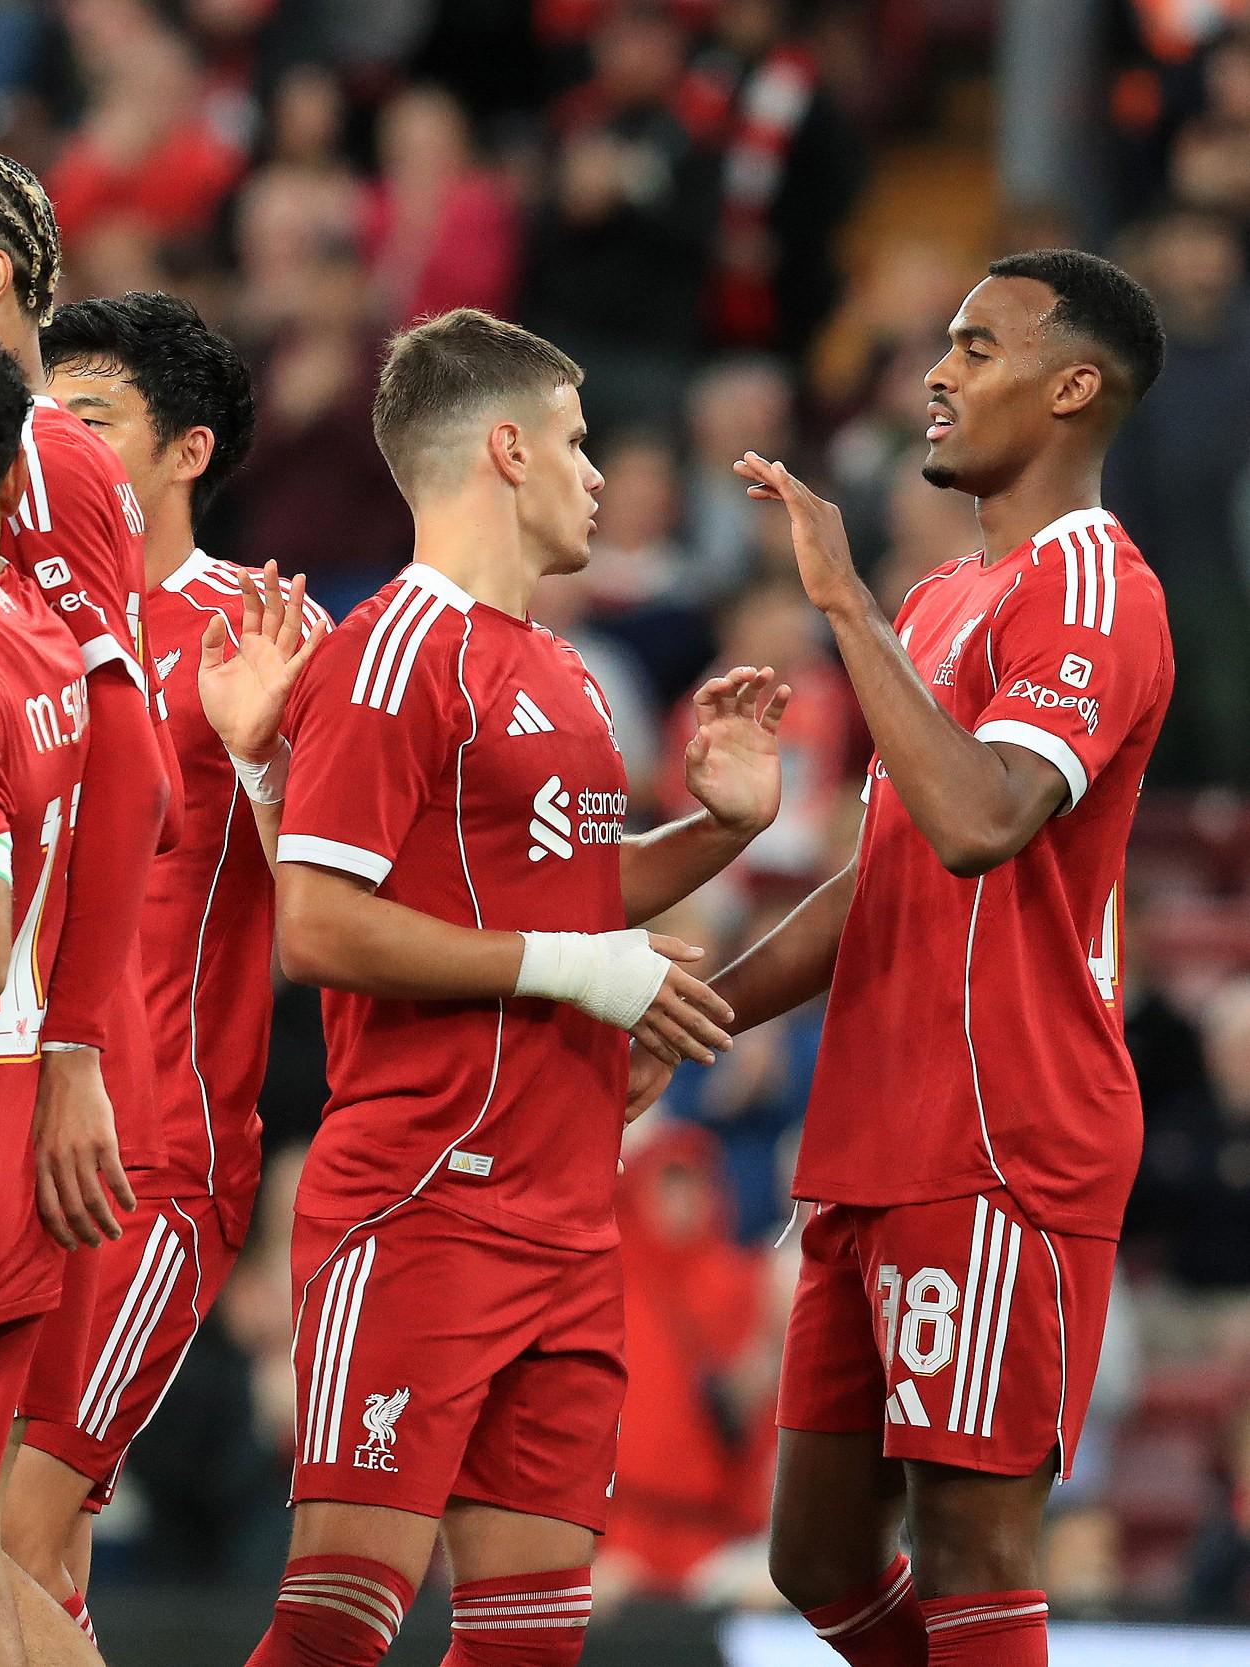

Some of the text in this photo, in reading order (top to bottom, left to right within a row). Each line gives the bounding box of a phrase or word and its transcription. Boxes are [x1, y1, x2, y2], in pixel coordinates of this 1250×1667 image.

[577, 787, 628, 816] standa
[578, 816, 624, 845] charte
[352, 1450, 399, 1473] L.F.C.
